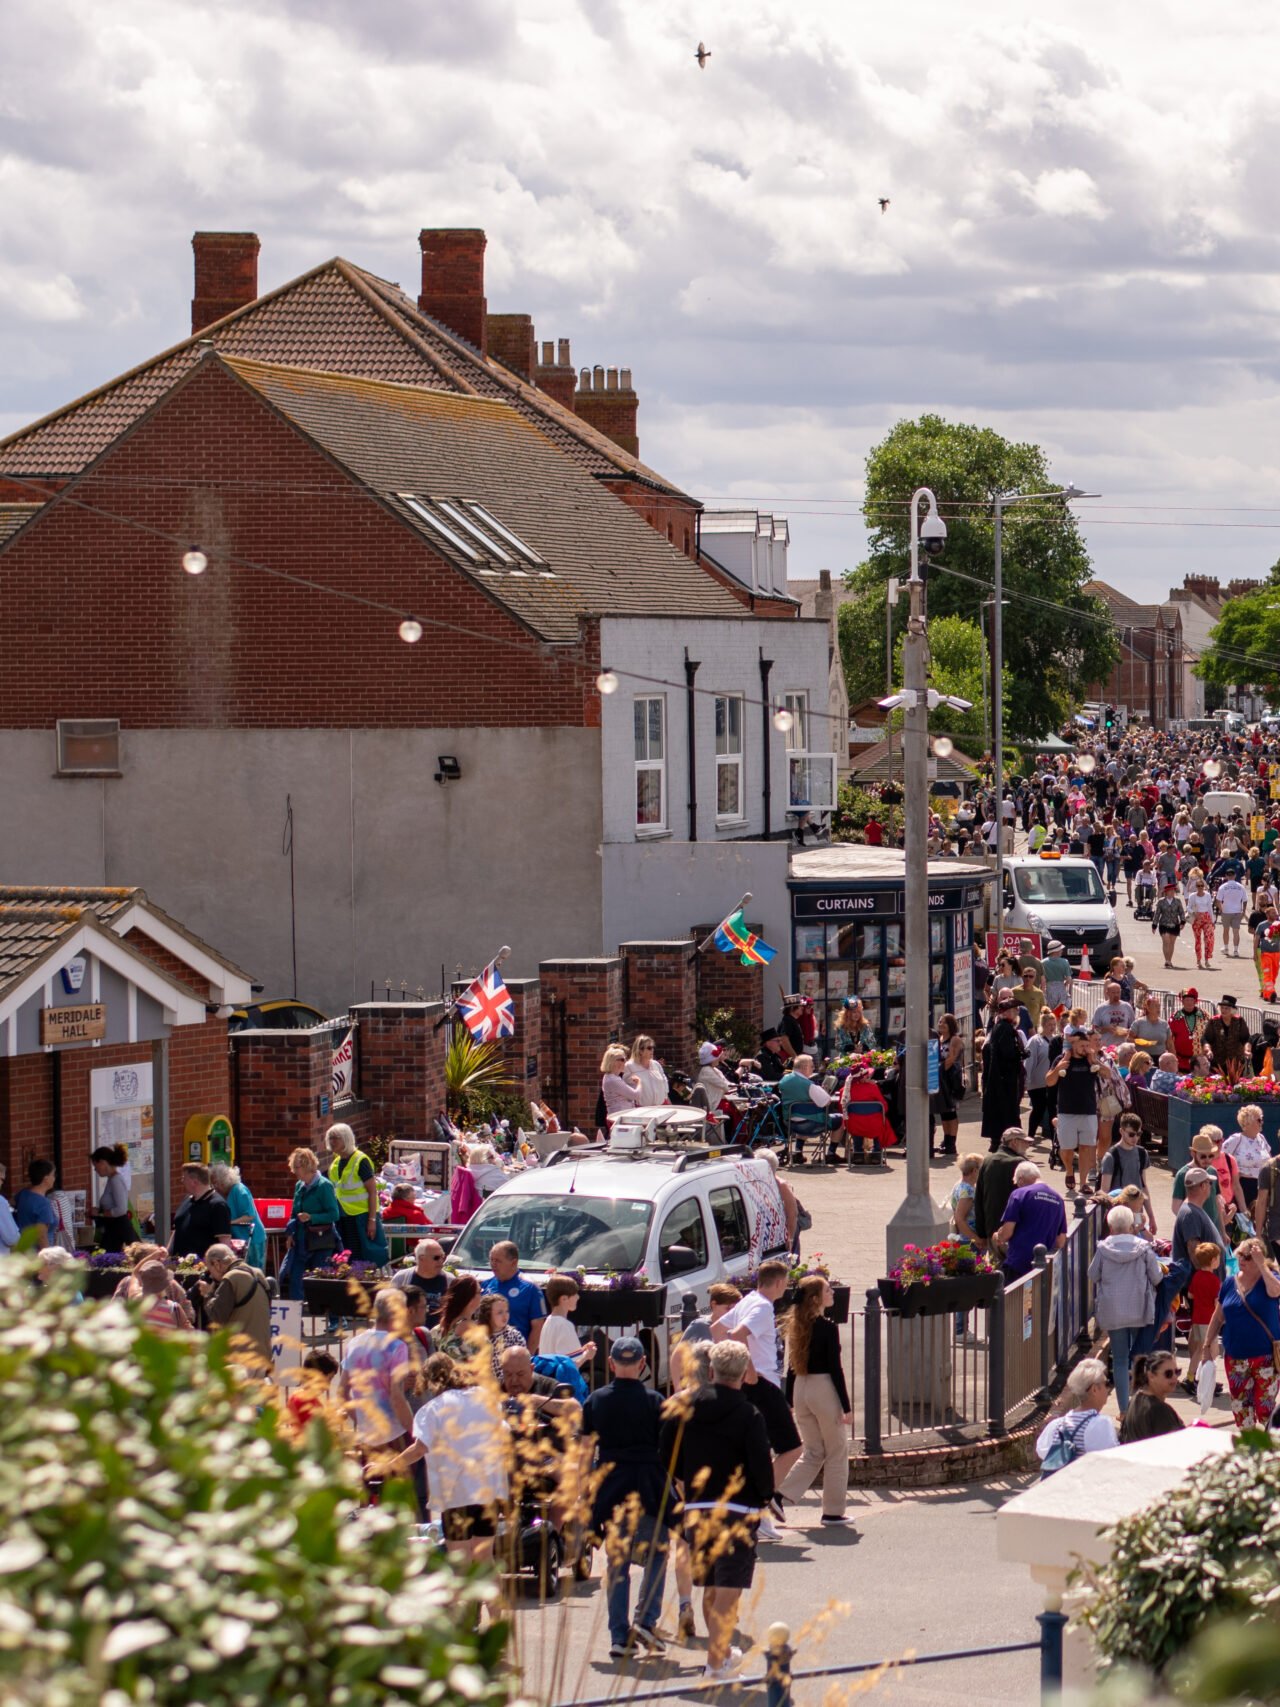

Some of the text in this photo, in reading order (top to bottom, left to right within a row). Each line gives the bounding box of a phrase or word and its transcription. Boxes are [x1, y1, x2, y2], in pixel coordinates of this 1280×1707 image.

[816, 898, 875, 911] CURTAINS
[928, 894, 945, 906] NDS
[48, 1008, 102, 1025] MERIDALE
[62, 1024, 88, 1038] HALL
